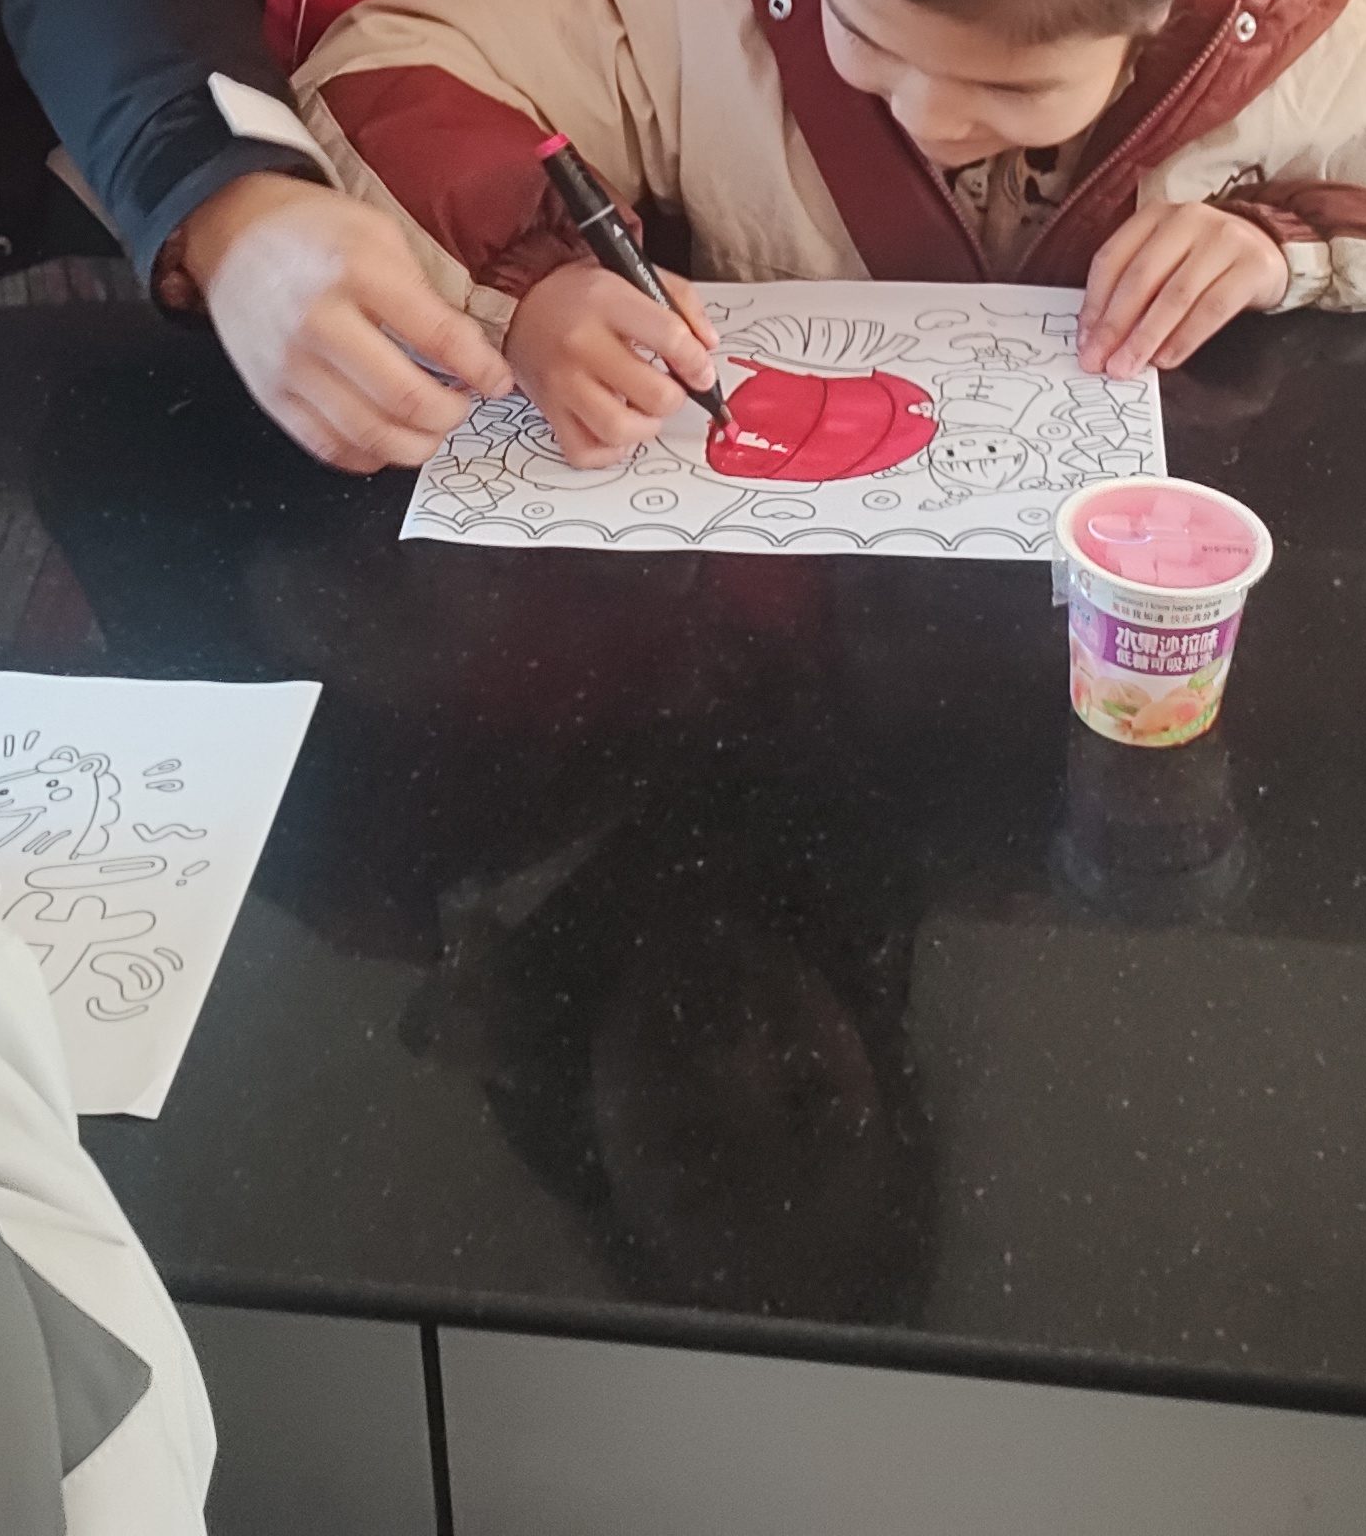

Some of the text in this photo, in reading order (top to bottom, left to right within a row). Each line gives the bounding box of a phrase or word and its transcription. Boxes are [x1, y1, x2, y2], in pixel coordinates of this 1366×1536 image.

[1115, 626, 1220, 659] 水果沙拉味
[1115, 646, 1214, 673] 低糖可吸果冻
